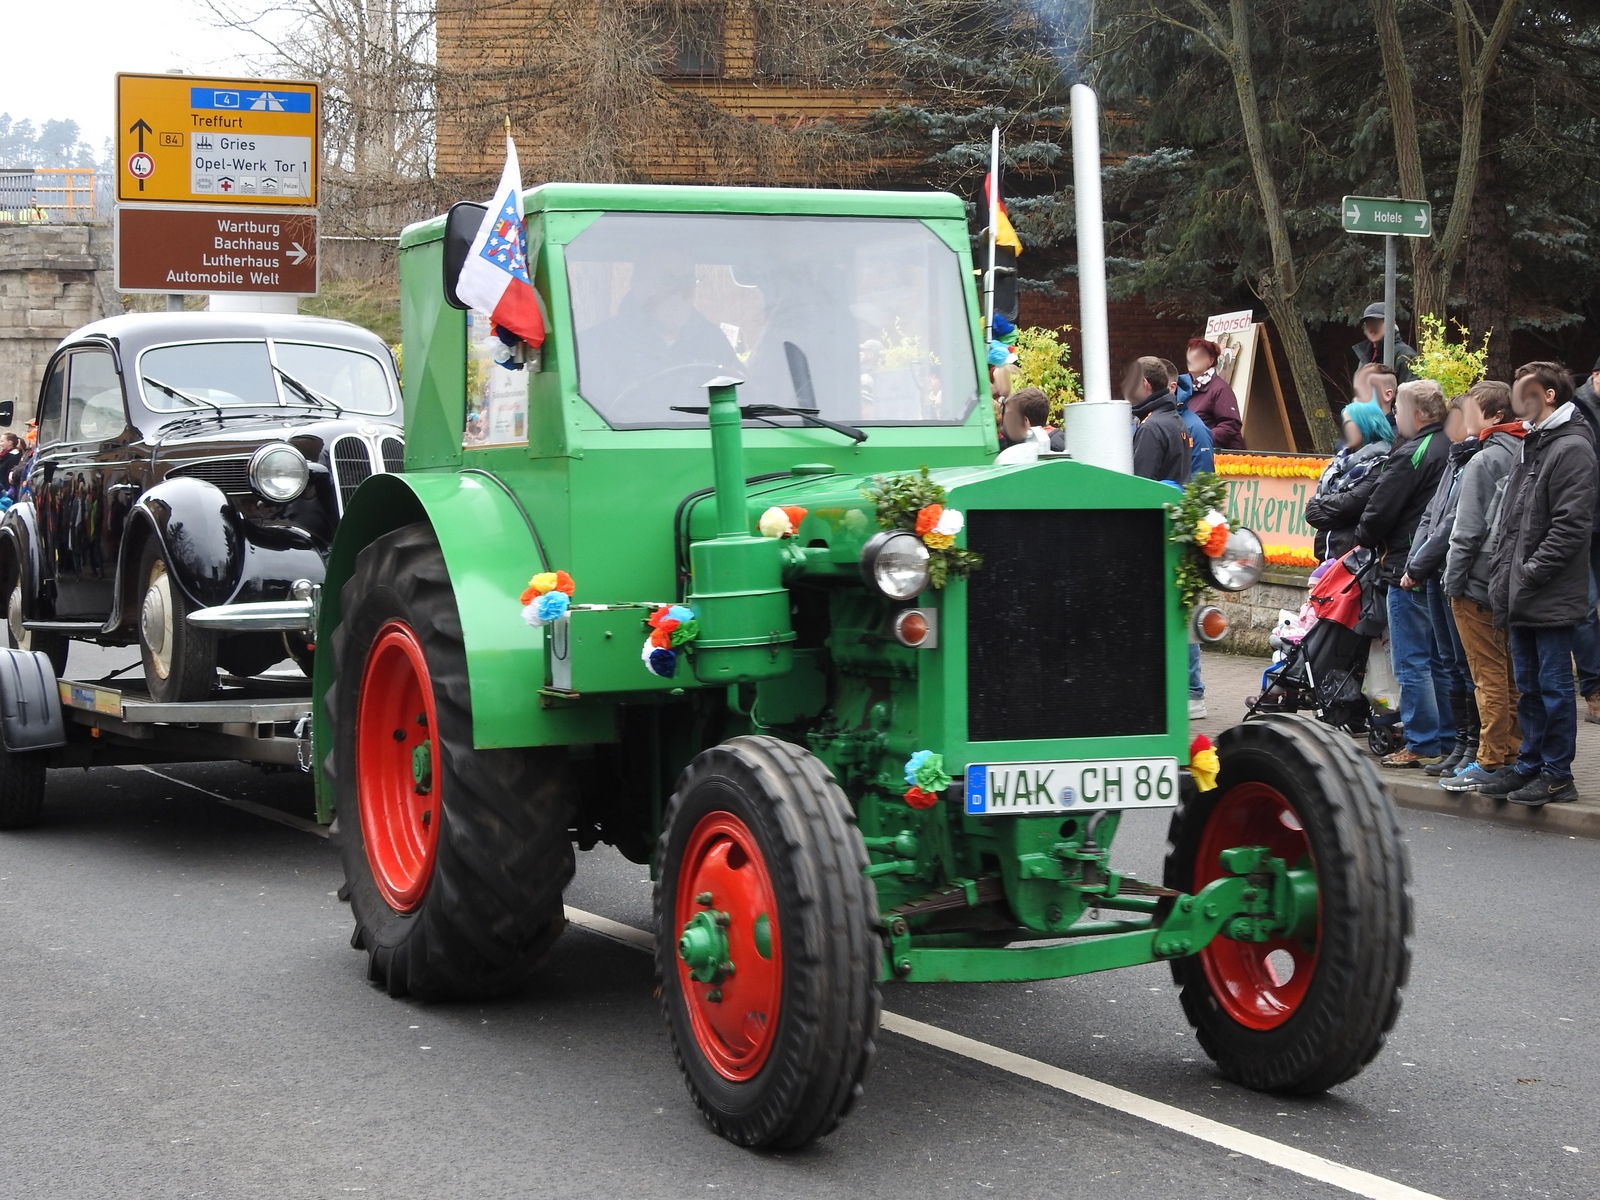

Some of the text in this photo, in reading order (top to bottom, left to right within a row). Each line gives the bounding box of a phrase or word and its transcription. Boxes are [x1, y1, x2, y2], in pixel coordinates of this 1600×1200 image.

[223, 95, 230, 105] 4
[191, 114, 243, 128] Treffurt
[165, 135, 178, 144] 84
[220, 138, 256, 151] Gries
[195, 157, 307, 173] Opel-Werk Tor 1
[1374, 211, 1403, 224] Hotels
[217, 219, 280, 236] Wartburg
[214, 237, 280, 251] Bachhaus
[203, 254, 280, 268] Lutherhaus
[166, 270, 280, 285] Automobile Welt
[1206, 313, 1251, 335] Schorsch
[1227, 479, 1316, 537] Kikerik
[972, 765, 1173, 807] D WAK CH 86
